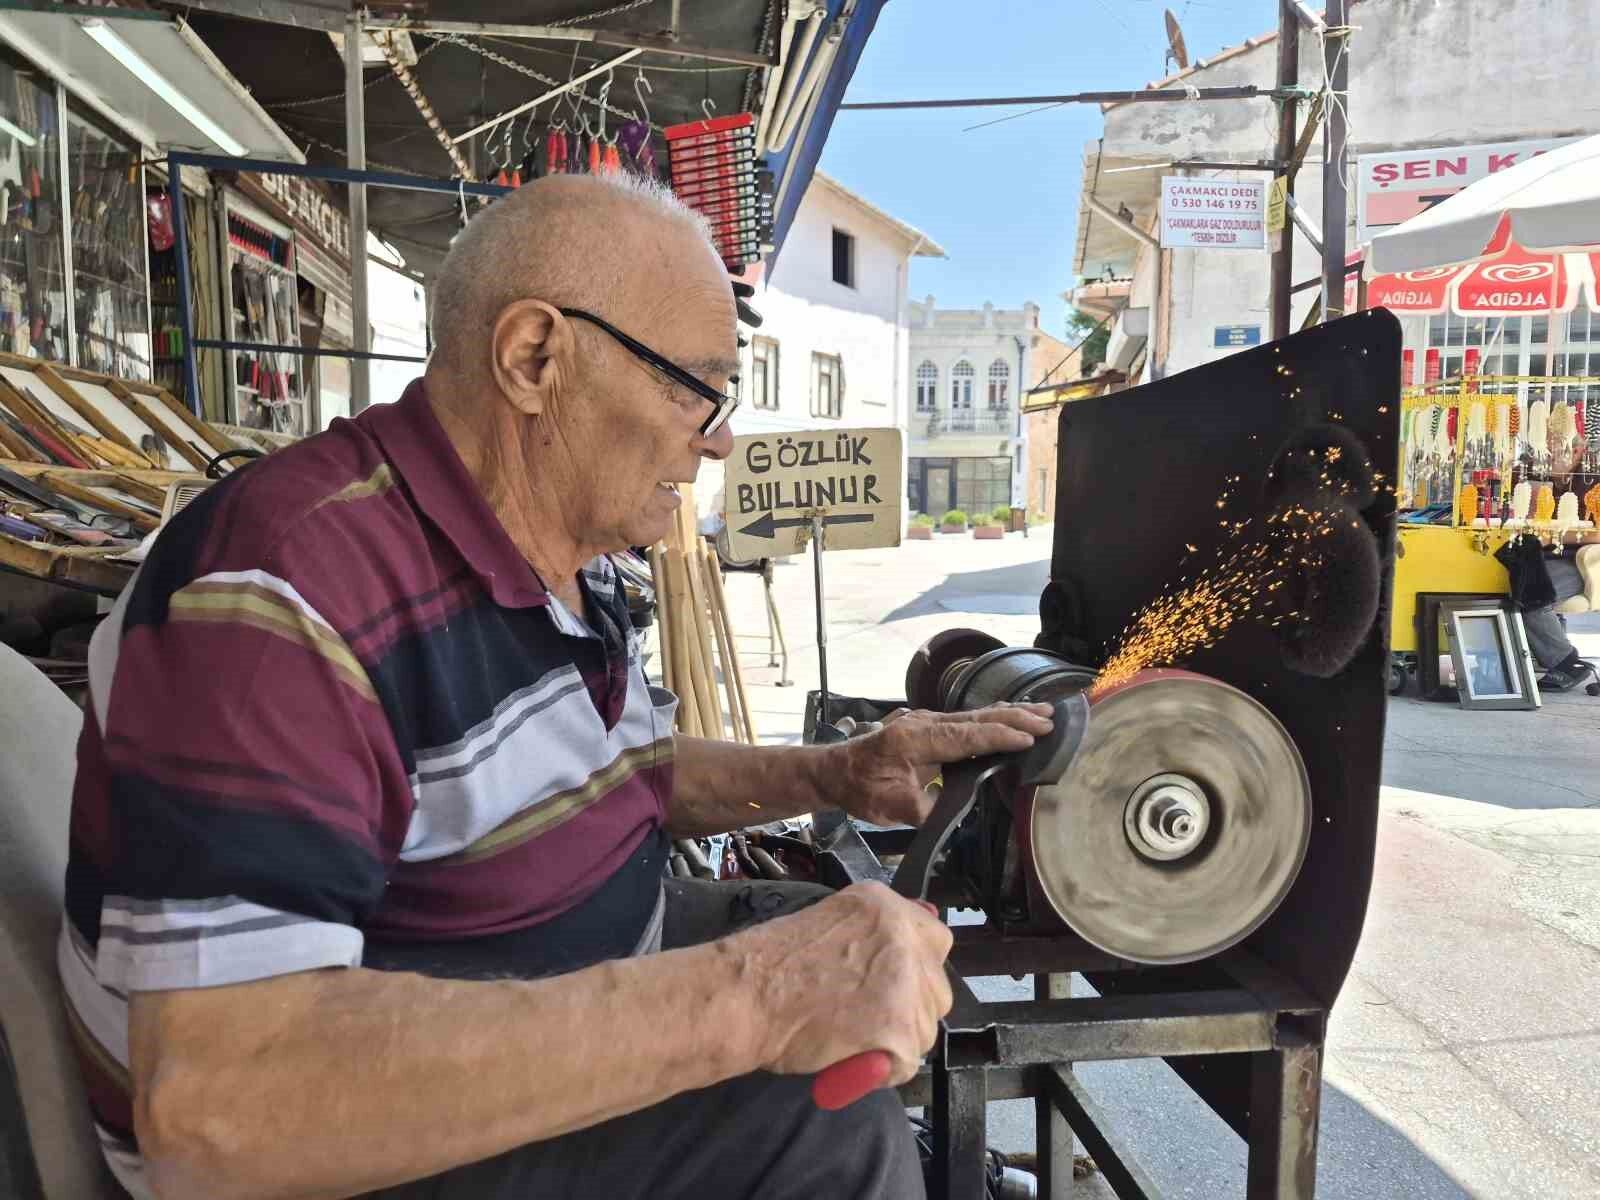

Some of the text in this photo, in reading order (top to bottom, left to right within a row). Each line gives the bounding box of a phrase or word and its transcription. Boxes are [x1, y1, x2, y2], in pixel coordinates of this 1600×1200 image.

[1372, 156, 1467, 187] ŞEN
[1171, 198, 1257, 209] 0 530 146 19 75
[1231, 188, 1259, 197] DEDE
[746, 433, 872, 473] GÖZLÜK
[737, 474, 882, 514] BULUNUR
